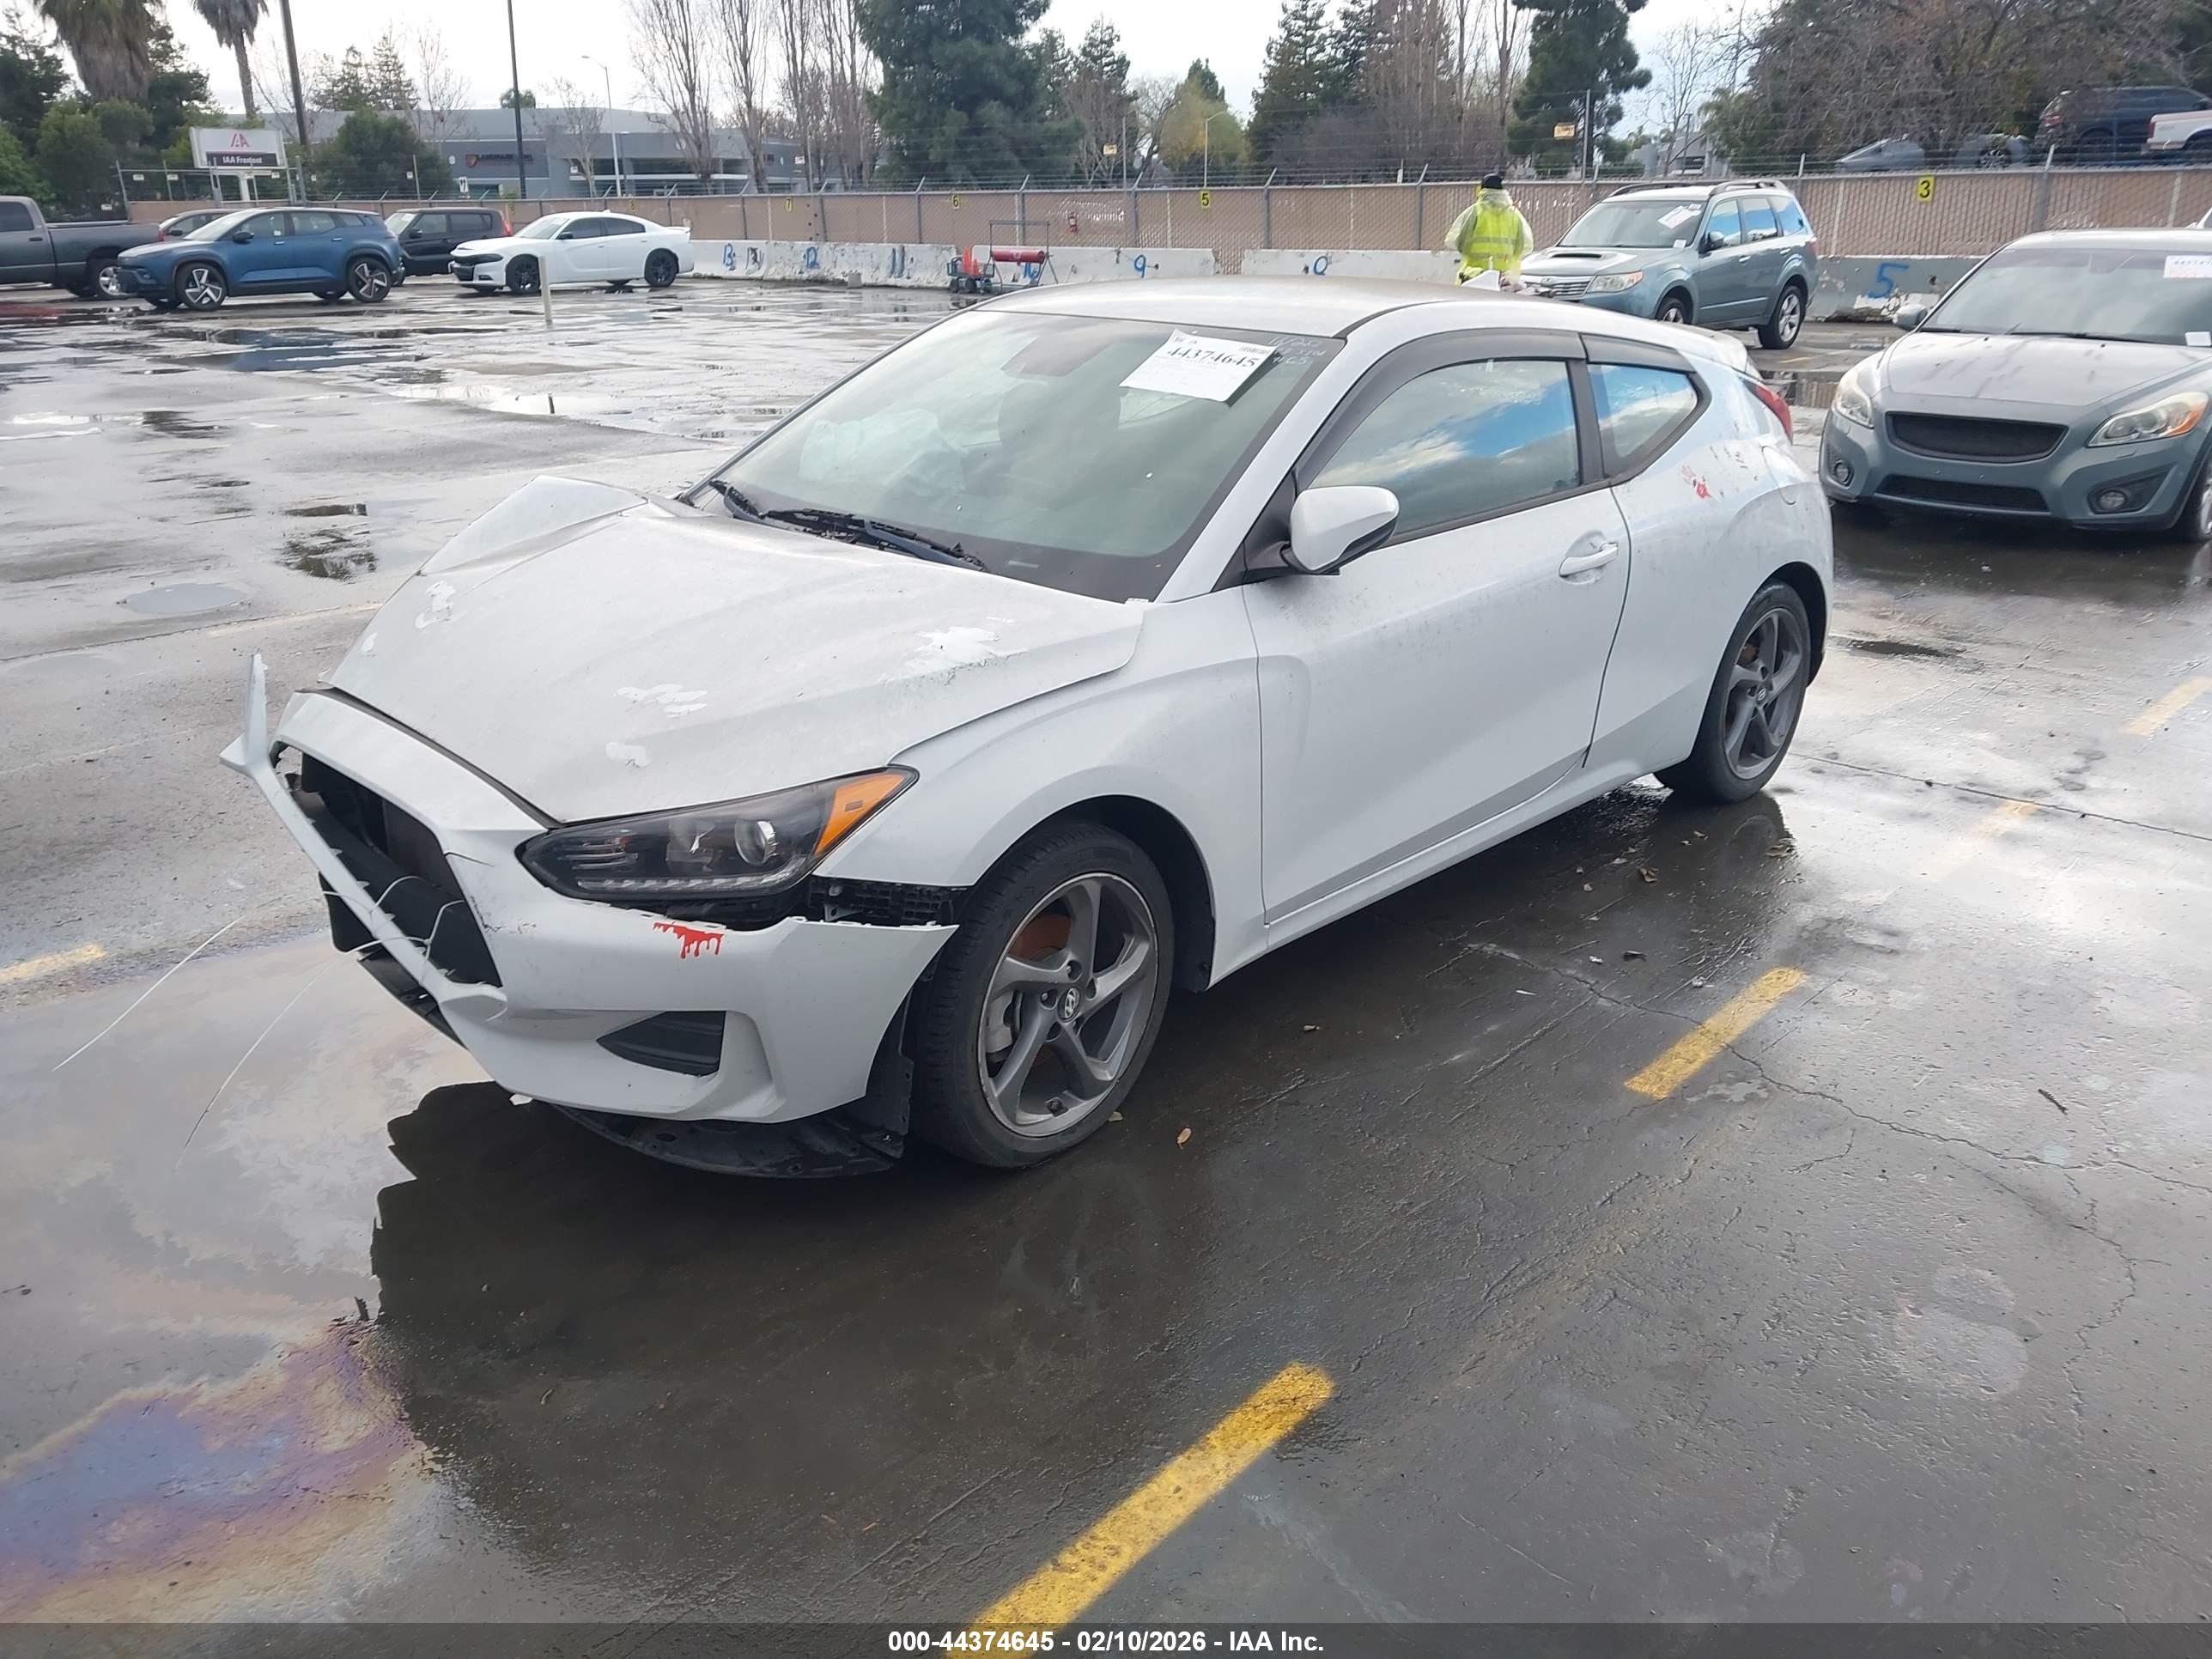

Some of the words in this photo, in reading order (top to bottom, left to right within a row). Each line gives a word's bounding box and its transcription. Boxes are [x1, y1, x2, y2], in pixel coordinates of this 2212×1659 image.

[222, 155, 236, 164] IAA
[1918, 179, 1931, 198] 3
[951, 195, 960, 208] 6
[1201, 192, 1210, 206] 5
[1133, 253, 1147, 279] 9
[1868, 262, 1911, 299] 5
[1166, 346, 1261, 368] 44374645
